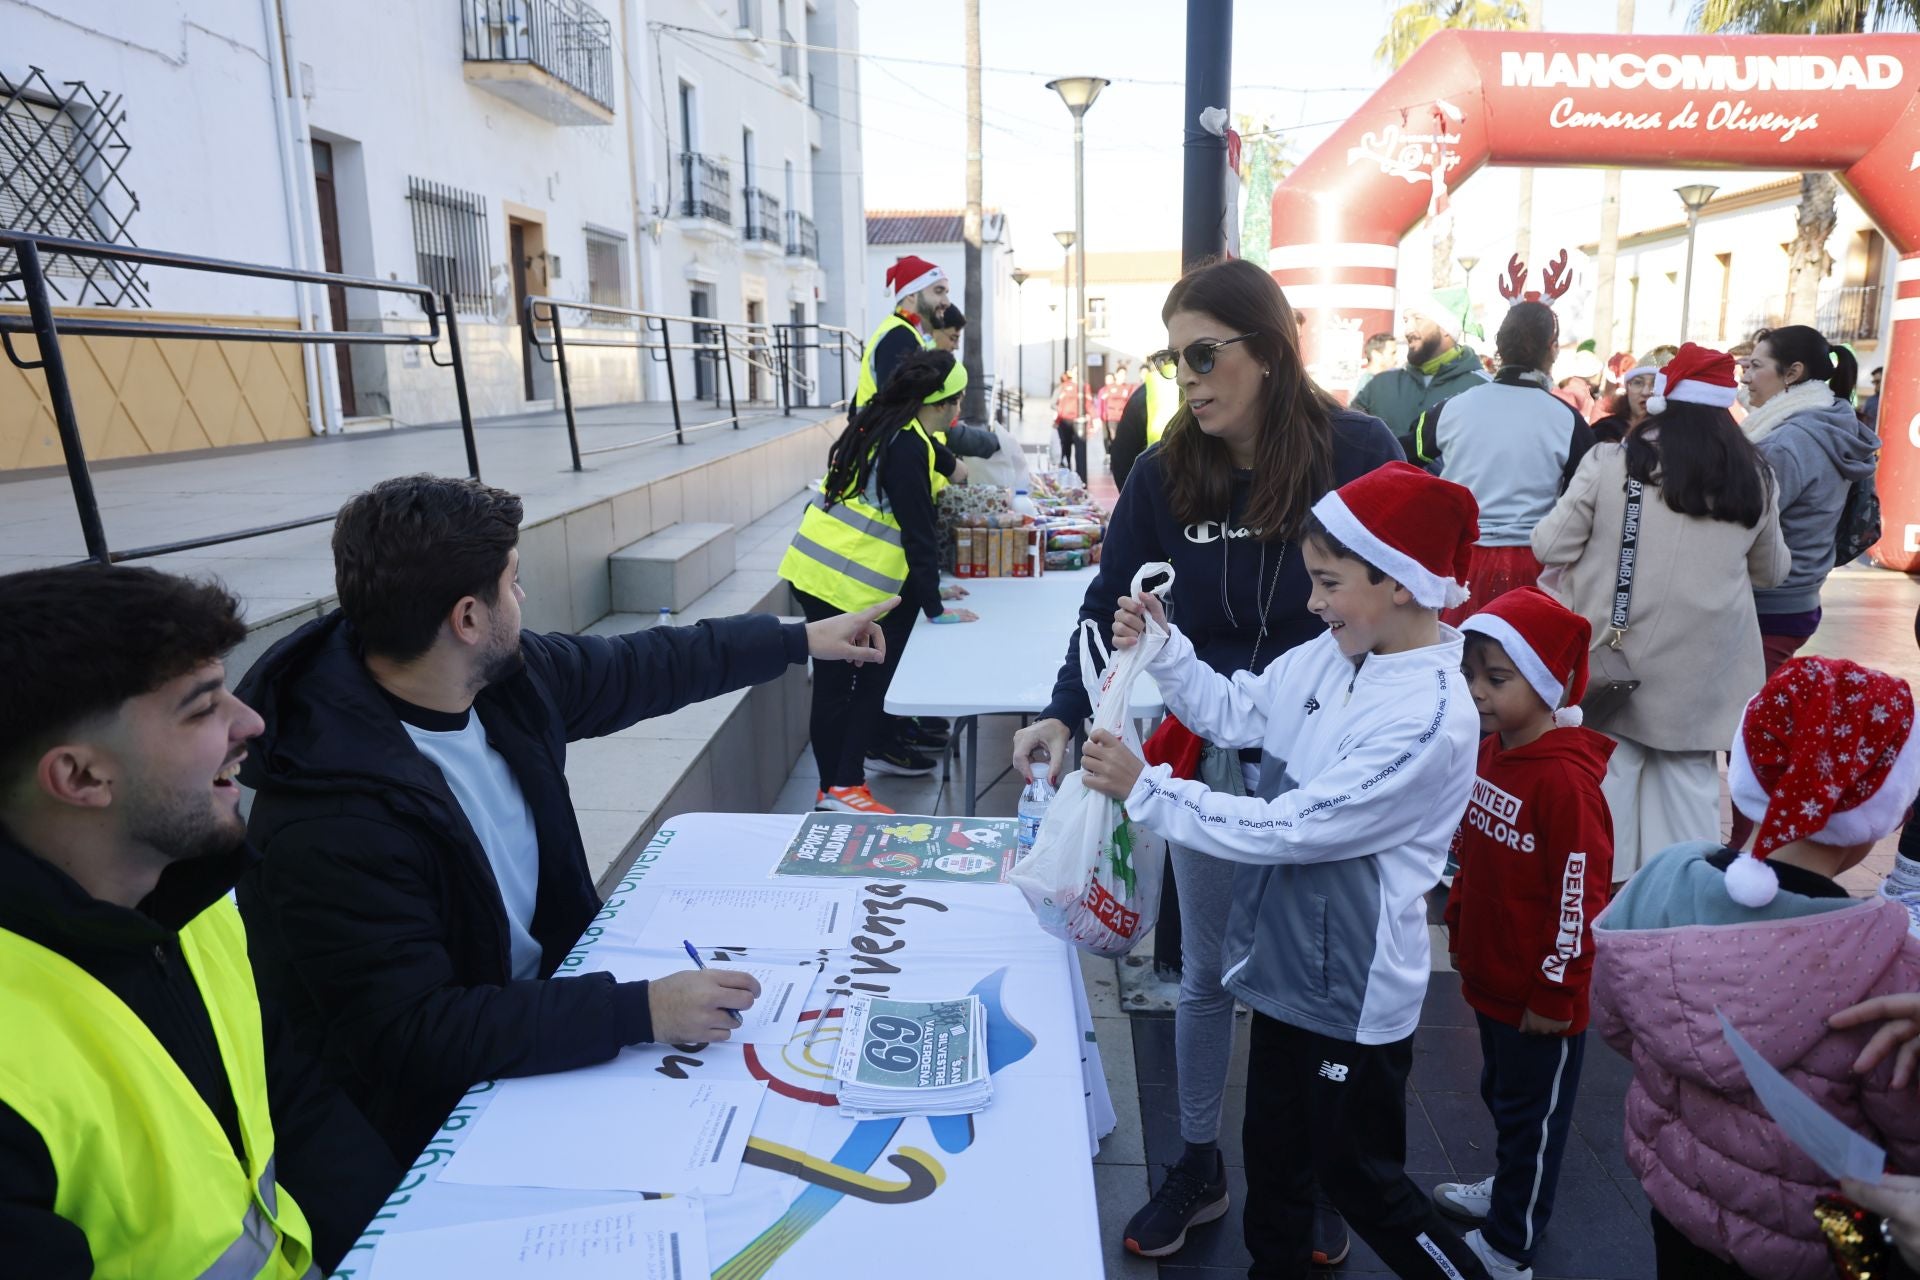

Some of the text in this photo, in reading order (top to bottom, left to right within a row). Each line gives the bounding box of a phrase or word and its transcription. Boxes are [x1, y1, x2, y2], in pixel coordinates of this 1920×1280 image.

[1501, 52, 1903, 92] MANCOMUNIDAD
[1549, 97, 1819, 143] Comarca de Olivenza
[1623, 503, 1640, 542] BIMBA
[1618, 549, 1634, 586] BIMBA
[1419, 711, 1445, 744] balance
[1361, 752, 1413, 790] new balance
[1162, 789, 1179, 800] new
[1299, 793, 1352, 819] new balance
[1472, 780, 1517, 818] NITED
[1207, 815, 1227, 824] new
[1238, 819, 1293, 829] new balance
[1468, 806, 1536, 853] COLORS
[797, 823, 830, 860] DEPORTE
[819, 824, 853, 863] SOLIDARIO
[1087, 884, 1136, 935] SPAR
[863, 1014, 924, 1074] 69
[918, 1019, 936, 1088] VALVERDEÑA
[934, 1032, 949, 1087] SILVESTRE
[951, 1059, 963, 1085] SAN
[1423, 1241, 1456, 1278] new balance
